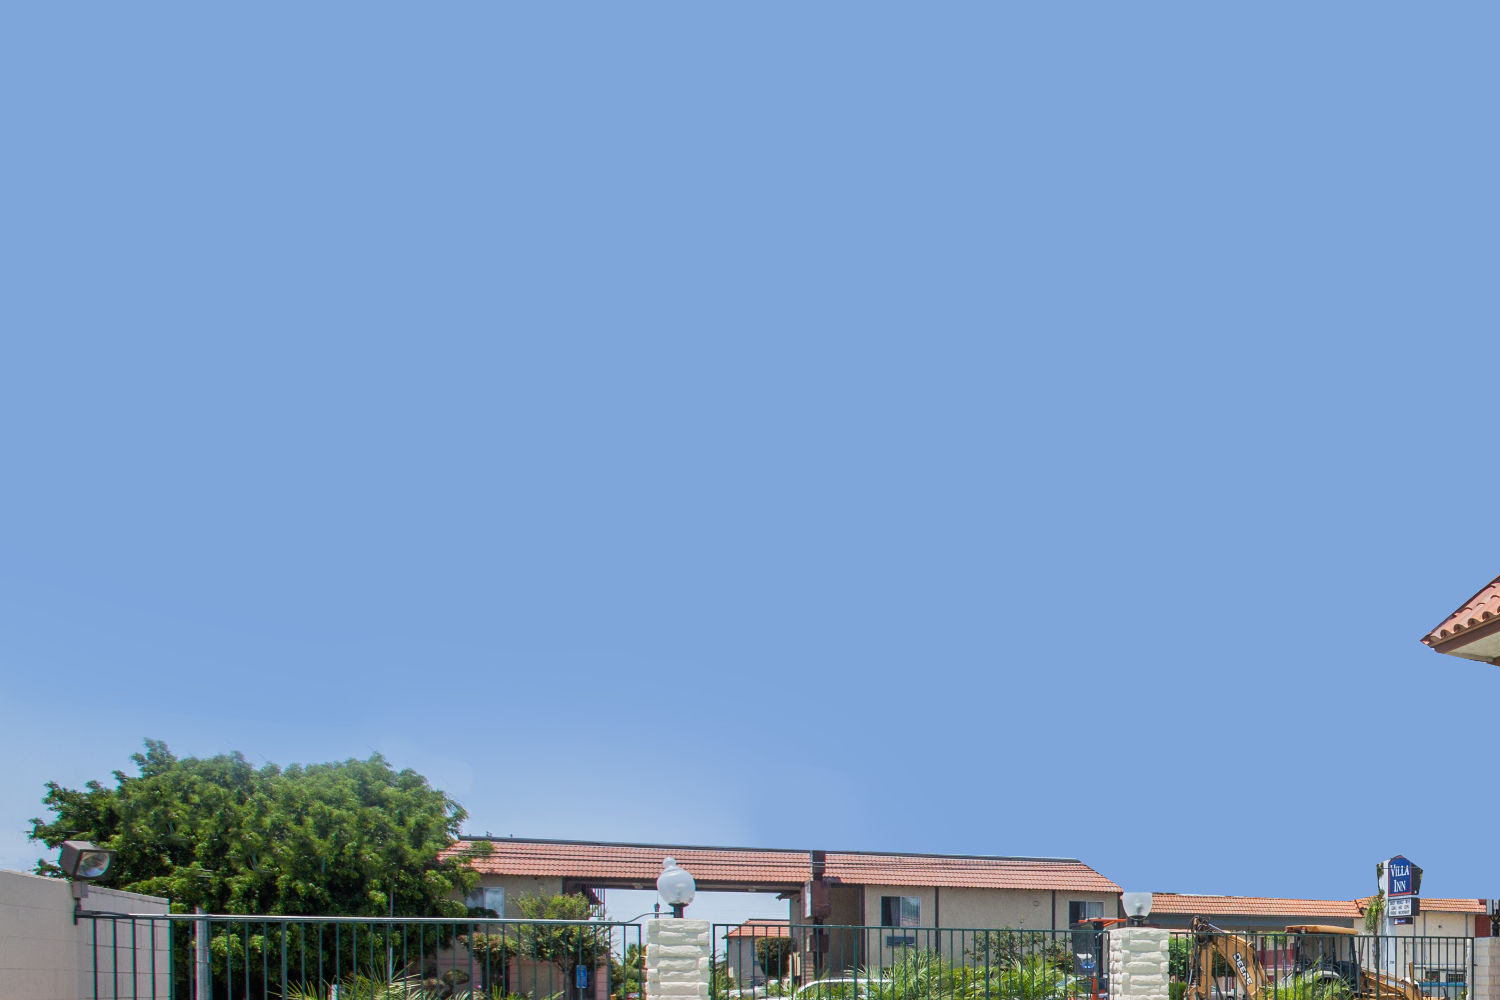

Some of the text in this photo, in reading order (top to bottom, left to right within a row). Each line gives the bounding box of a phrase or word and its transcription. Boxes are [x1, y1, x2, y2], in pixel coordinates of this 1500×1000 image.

[1390, 864, 1410, 877] VILLA
[1393, 880, 1406, 892] INN
[1232, 952, 1253, 986] DEERE
